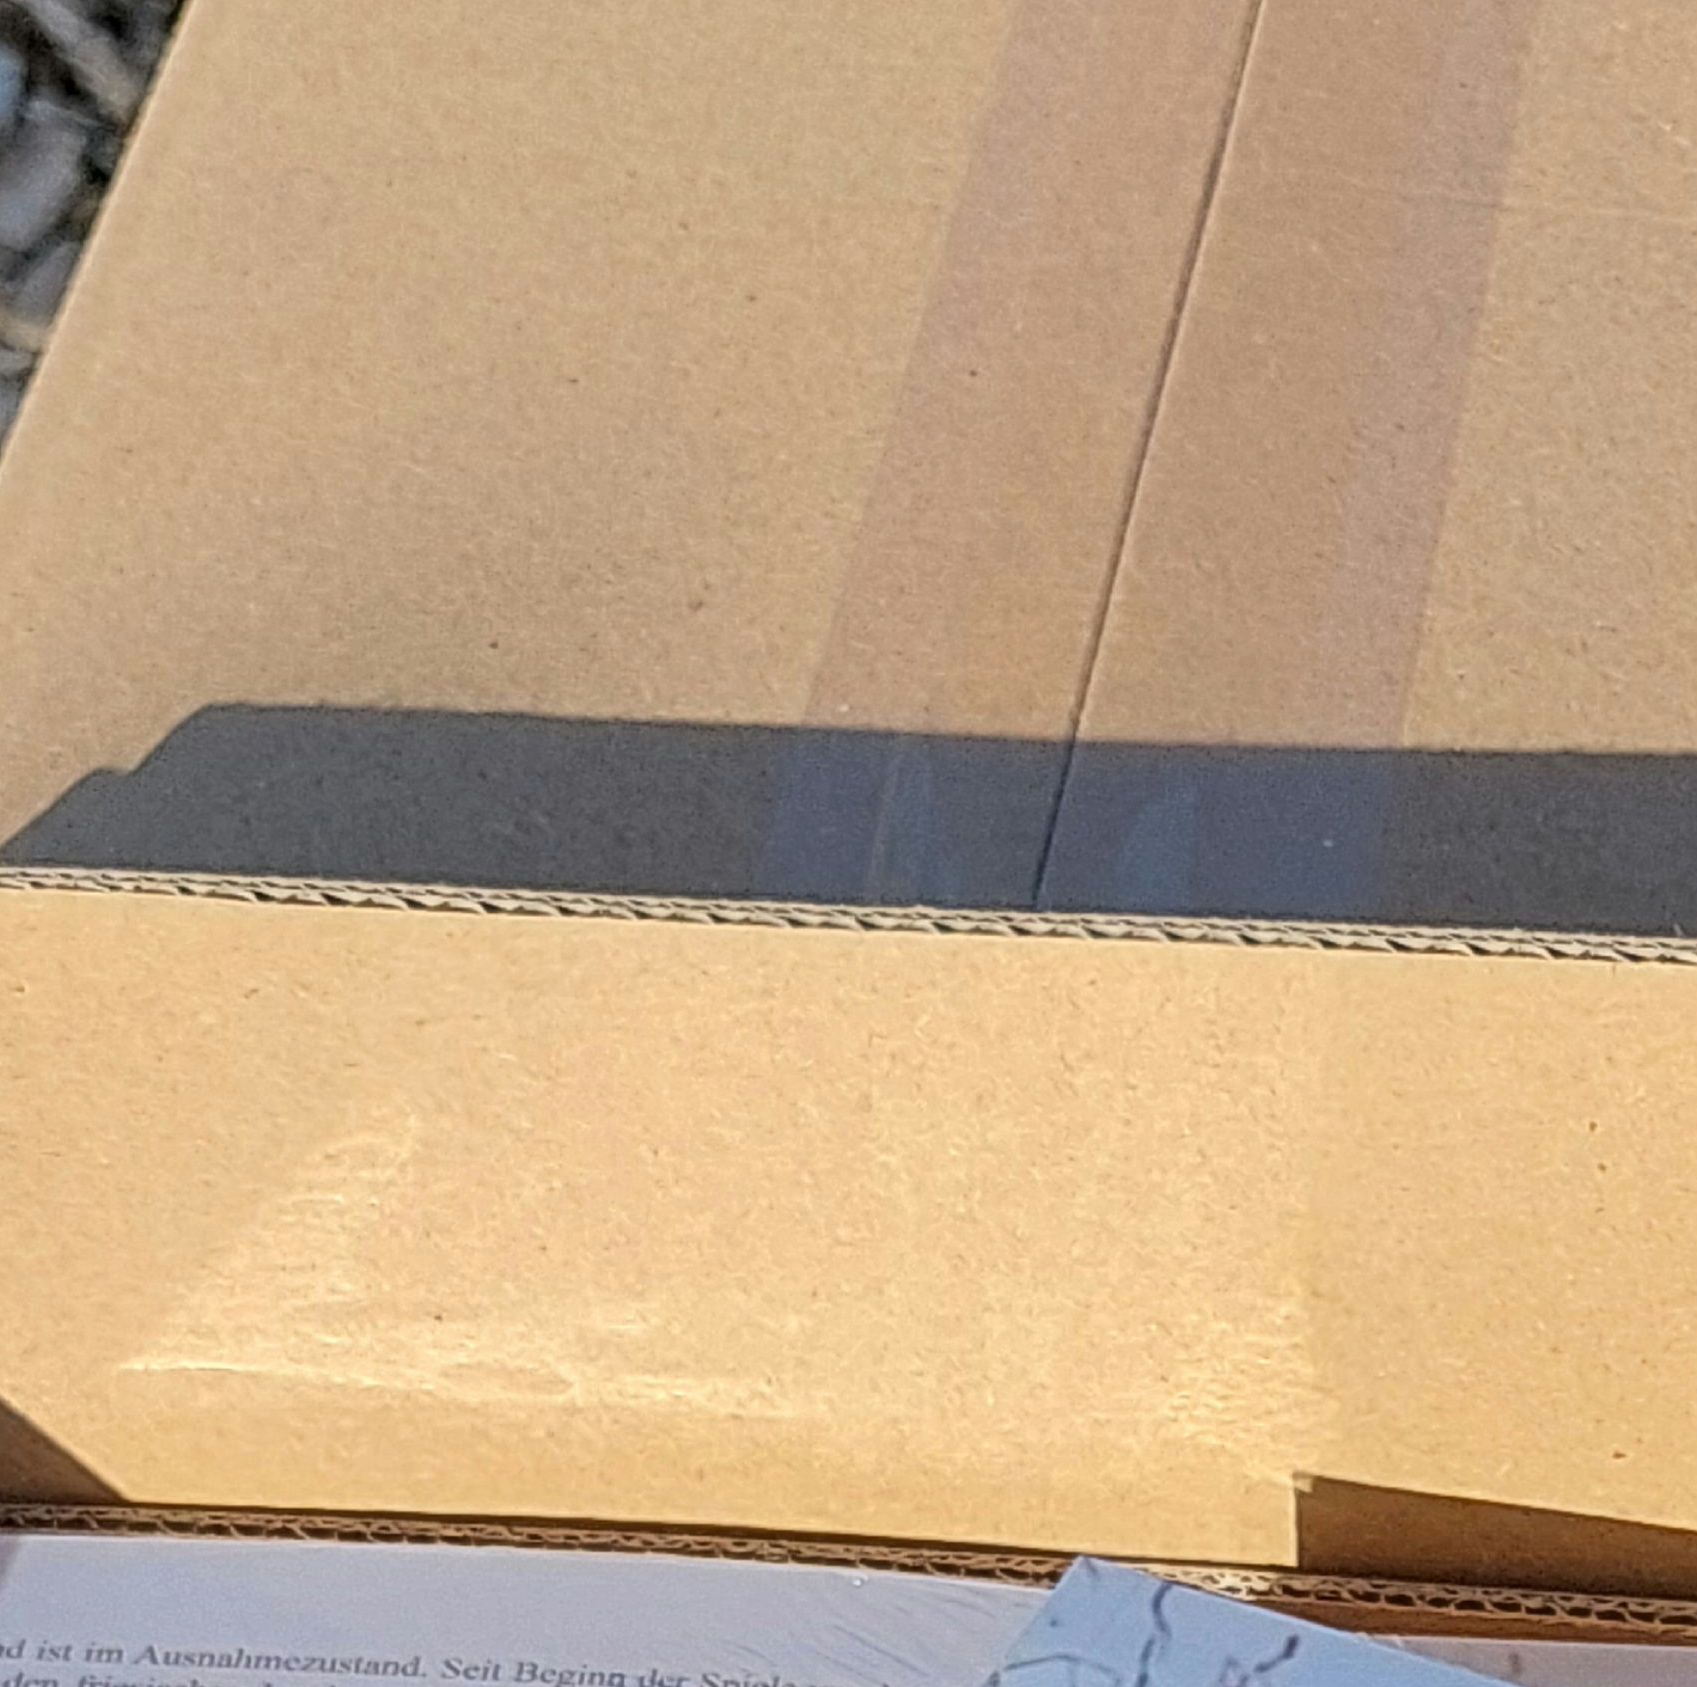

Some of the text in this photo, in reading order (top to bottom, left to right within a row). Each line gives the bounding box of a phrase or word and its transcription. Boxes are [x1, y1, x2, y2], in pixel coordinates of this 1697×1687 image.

[36, 1639, 73, 1662] ist
[84, 1641, 124, 1663] im
[440, 1657, 501, 1681] Seit
